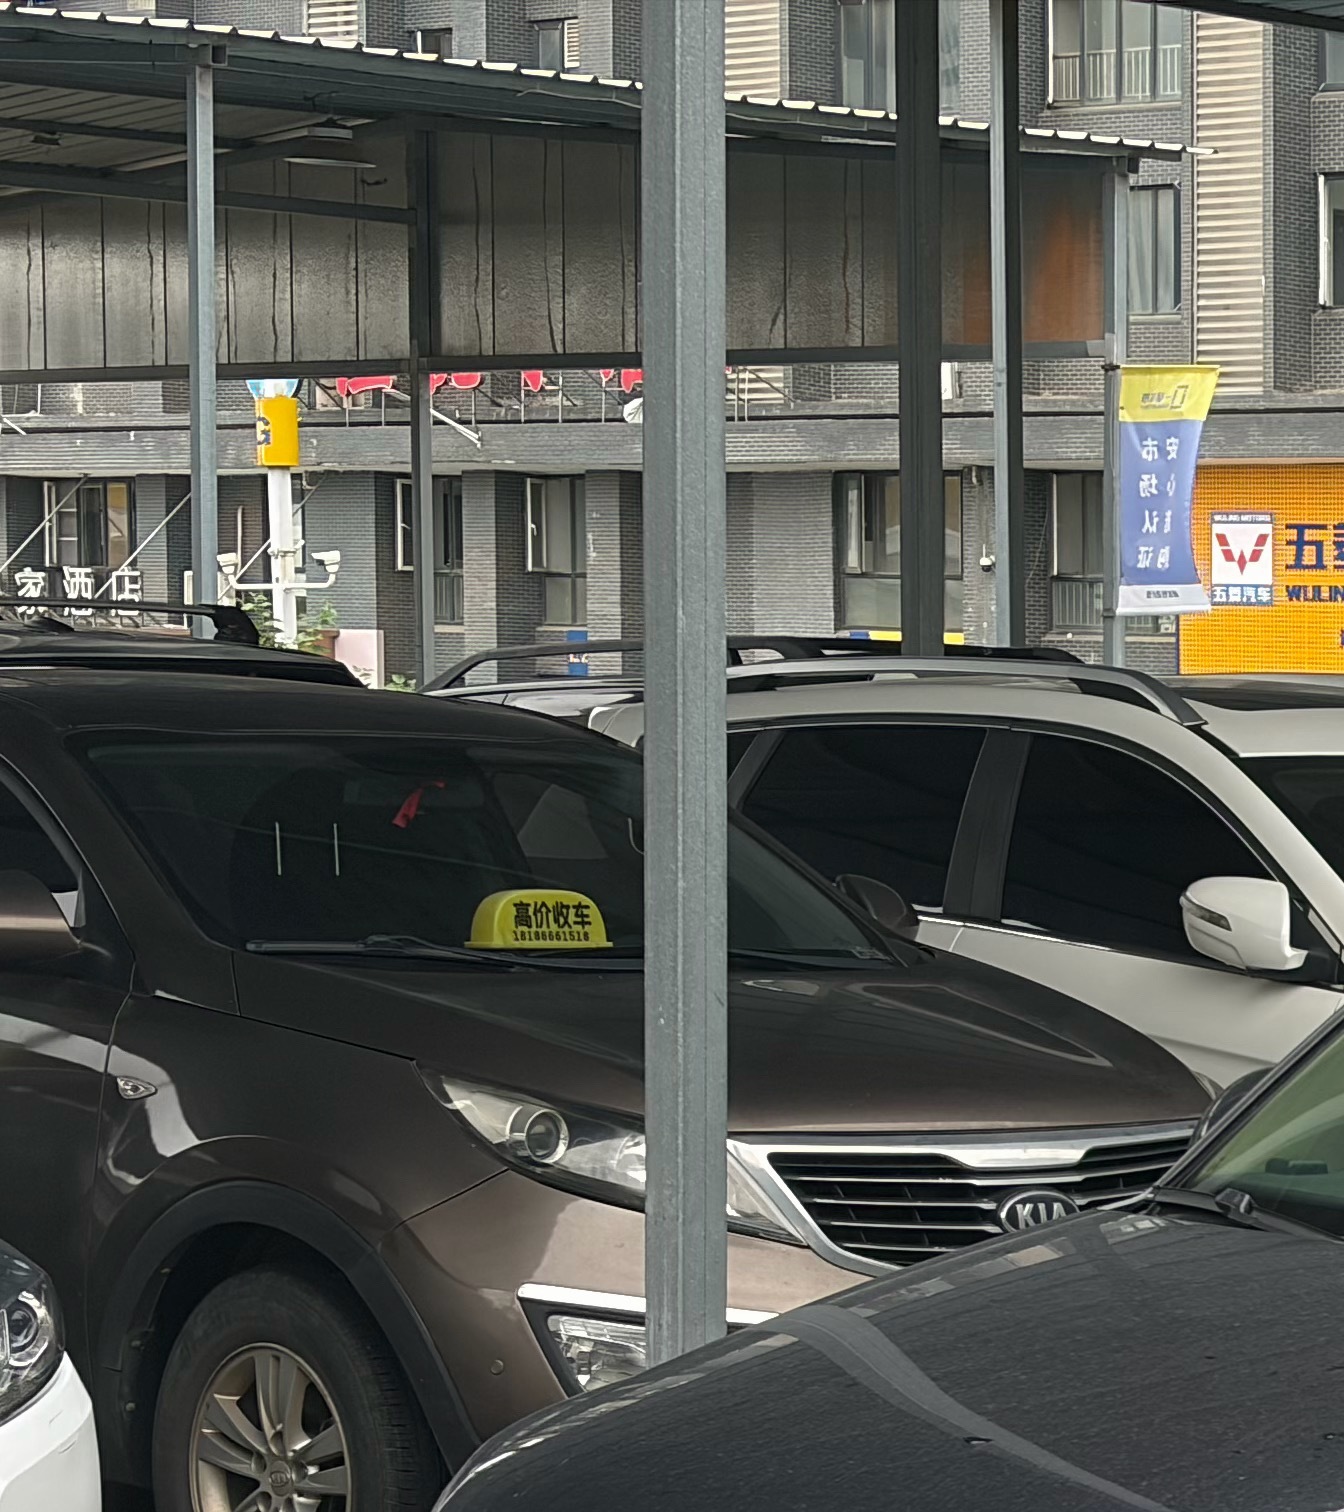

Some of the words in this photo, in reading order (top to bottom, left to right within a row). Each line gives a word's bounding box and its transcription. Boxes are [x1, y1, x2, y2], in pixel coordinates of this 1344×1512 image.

[14, 566, 142, 617] 家酒店
[513, 901, 592, 930] 高价收车
[1016, 1202, 1067, 1231] KIA
